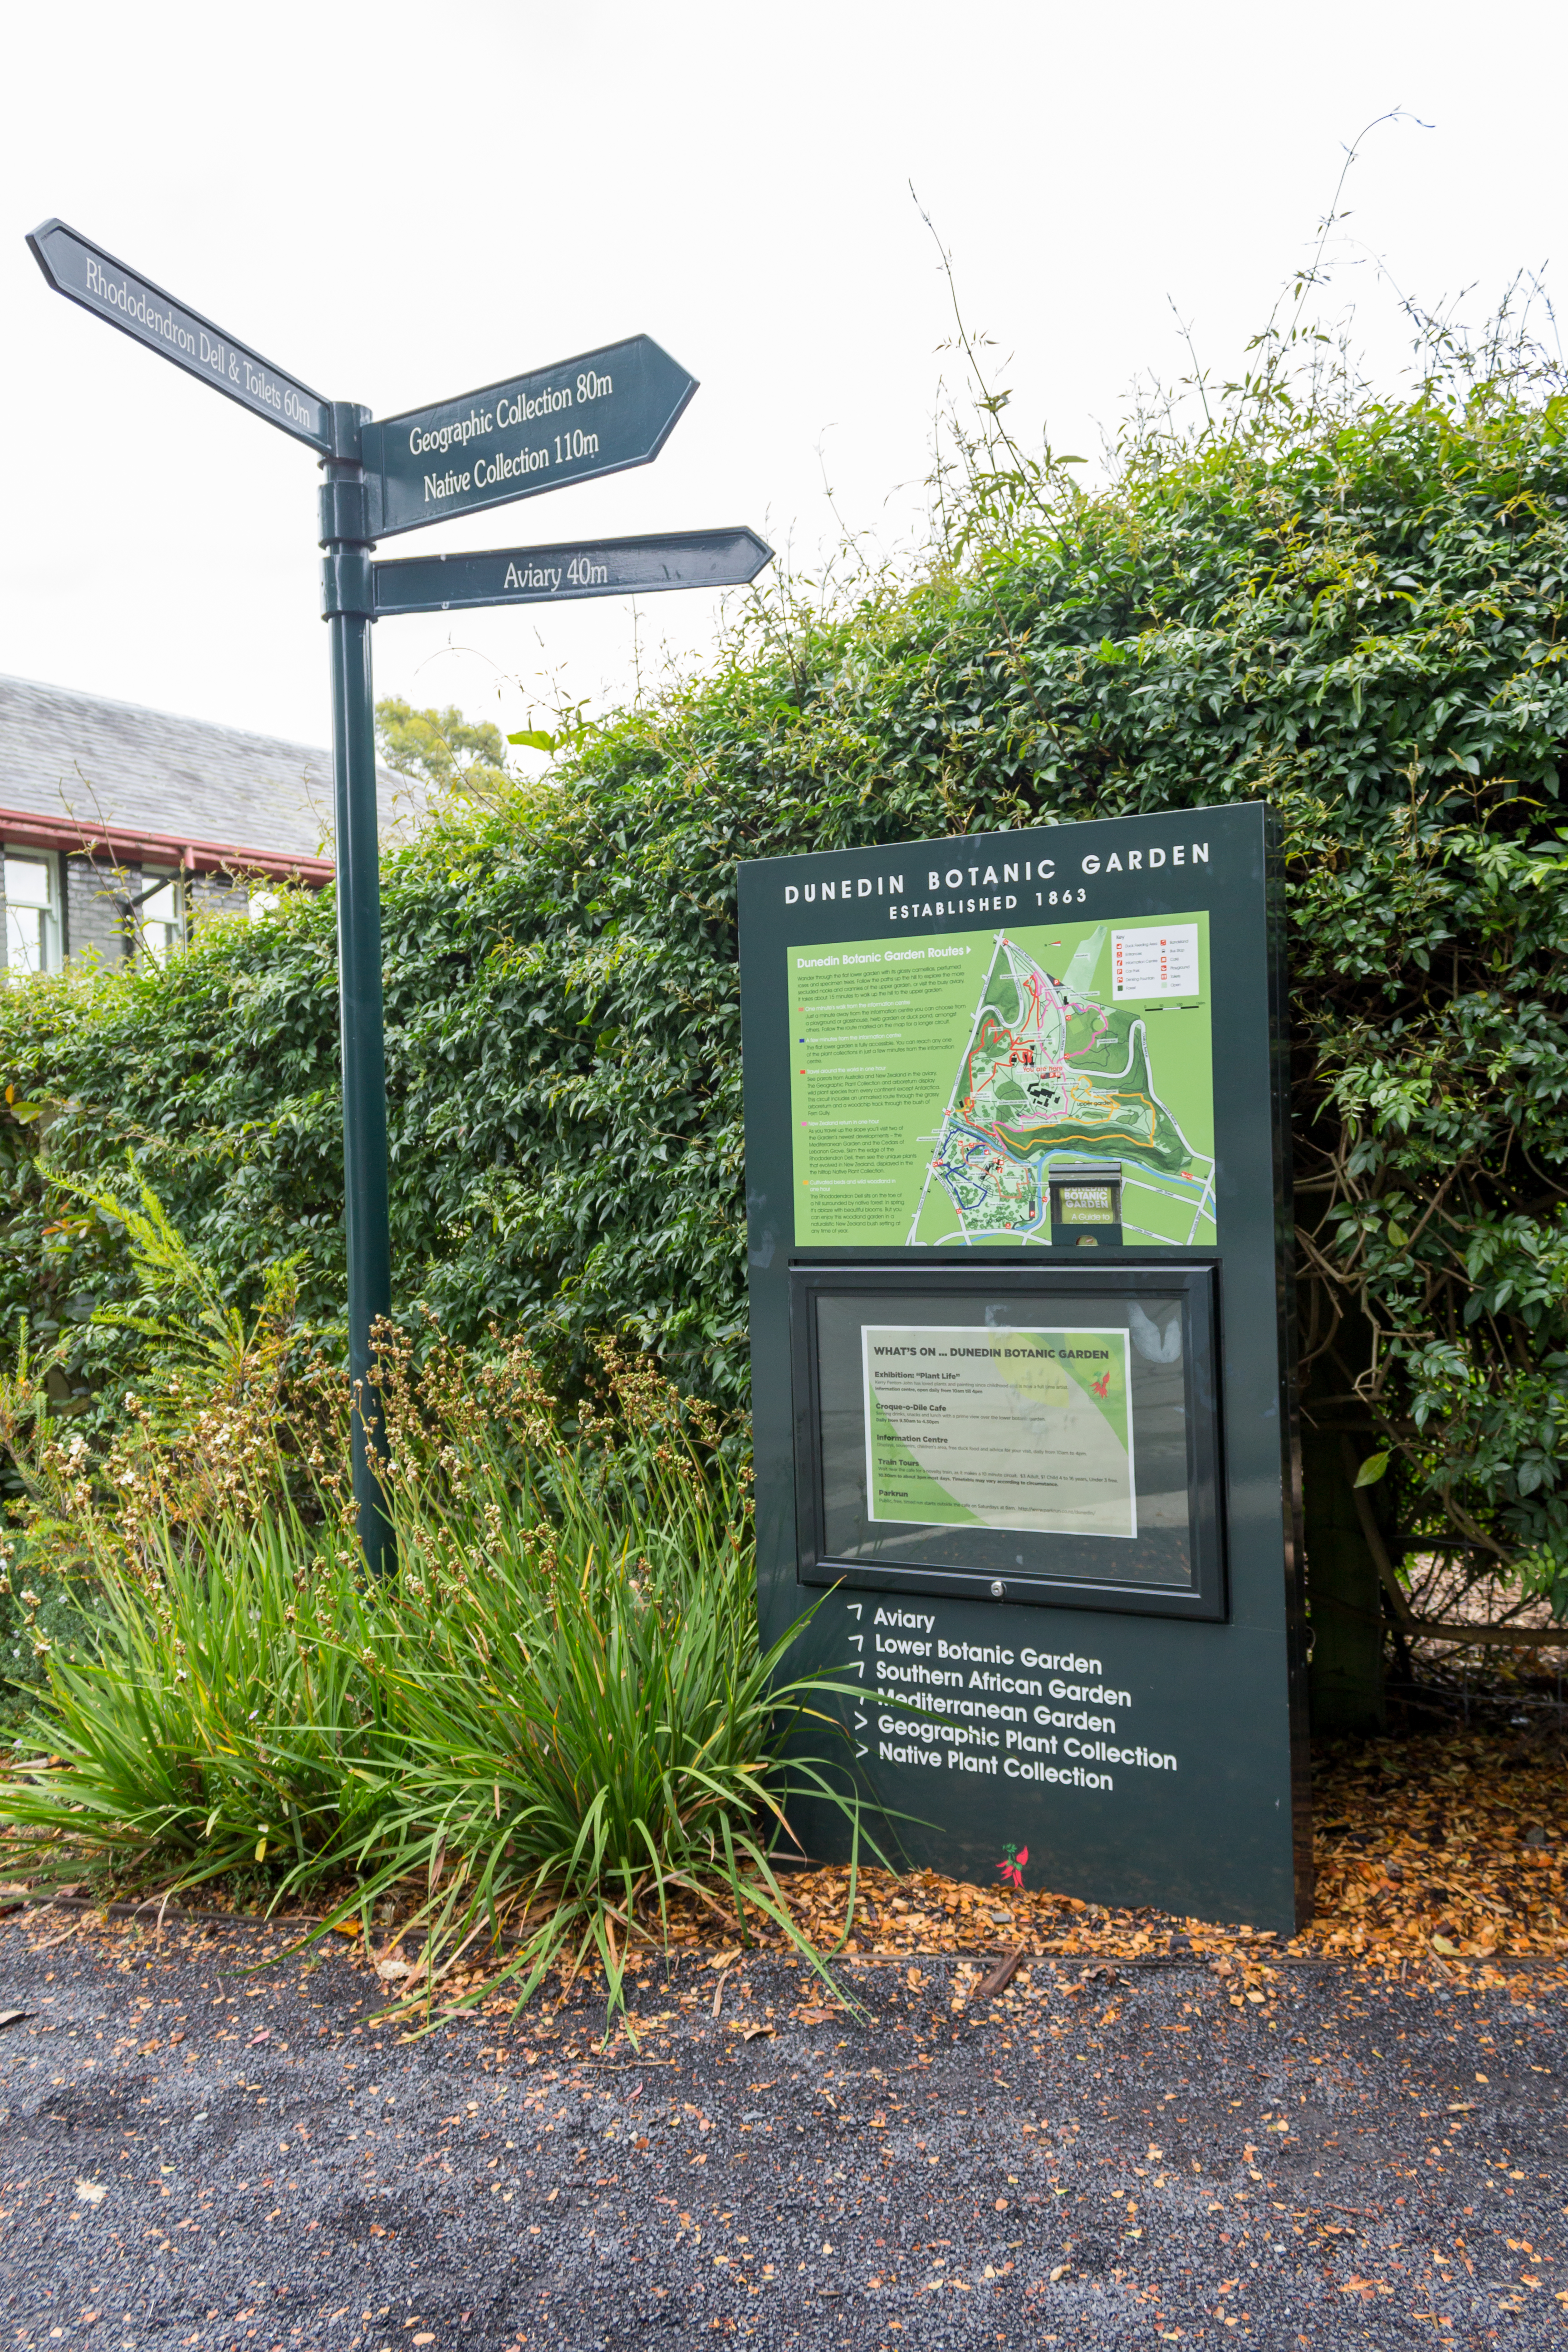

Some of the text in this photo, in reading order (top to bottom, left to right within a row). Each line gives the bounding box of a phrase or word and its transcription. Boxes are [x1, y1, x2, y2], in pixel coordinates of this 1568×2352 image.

[86, 257, 310, 428] Rhododendron Dell & Toilets 60m
[409, 371, 613, 455] Geographic Collection 80m
[424, 429, 599, 502] Native Collection 110m
[504, 557, 608, 591] Aviary 40m
[785, 843, 1208, 904] DUNEDIN BOTANIC GARDEN
[889, 888, 1086, 920] ESTABLISHED 1863
[797, 946, 964, 968] Dunedin Botanic Garden Routes
[1064, 1191, 1107, 1200] BOTANIC
[1065, 1200, 1108, 1208] GARDEN
[919, 1347, 936, 1356] ON
[950, 1348, 1001, 1357] DUNEDIN
[1004, 1348, 1055, 1358] BOTANIC
[1058, 1349, 1108, 1359] GARDEN
[875, 1403, 927, 1411] Croque-o-Dile
[873, 1607, 935, 1633] Aviary
[875, 1633, 1102, 1675] Lower Botanic Garden
[876, 1660, 1131, 1707] Southern African Garden
[877, 1687, 1115, 1734] Mediterranean Garden
[878, 1714, 1177, 1771] Geographic Plant Collection
[879, 1741, 1113, 1791] Native Plant Collection
